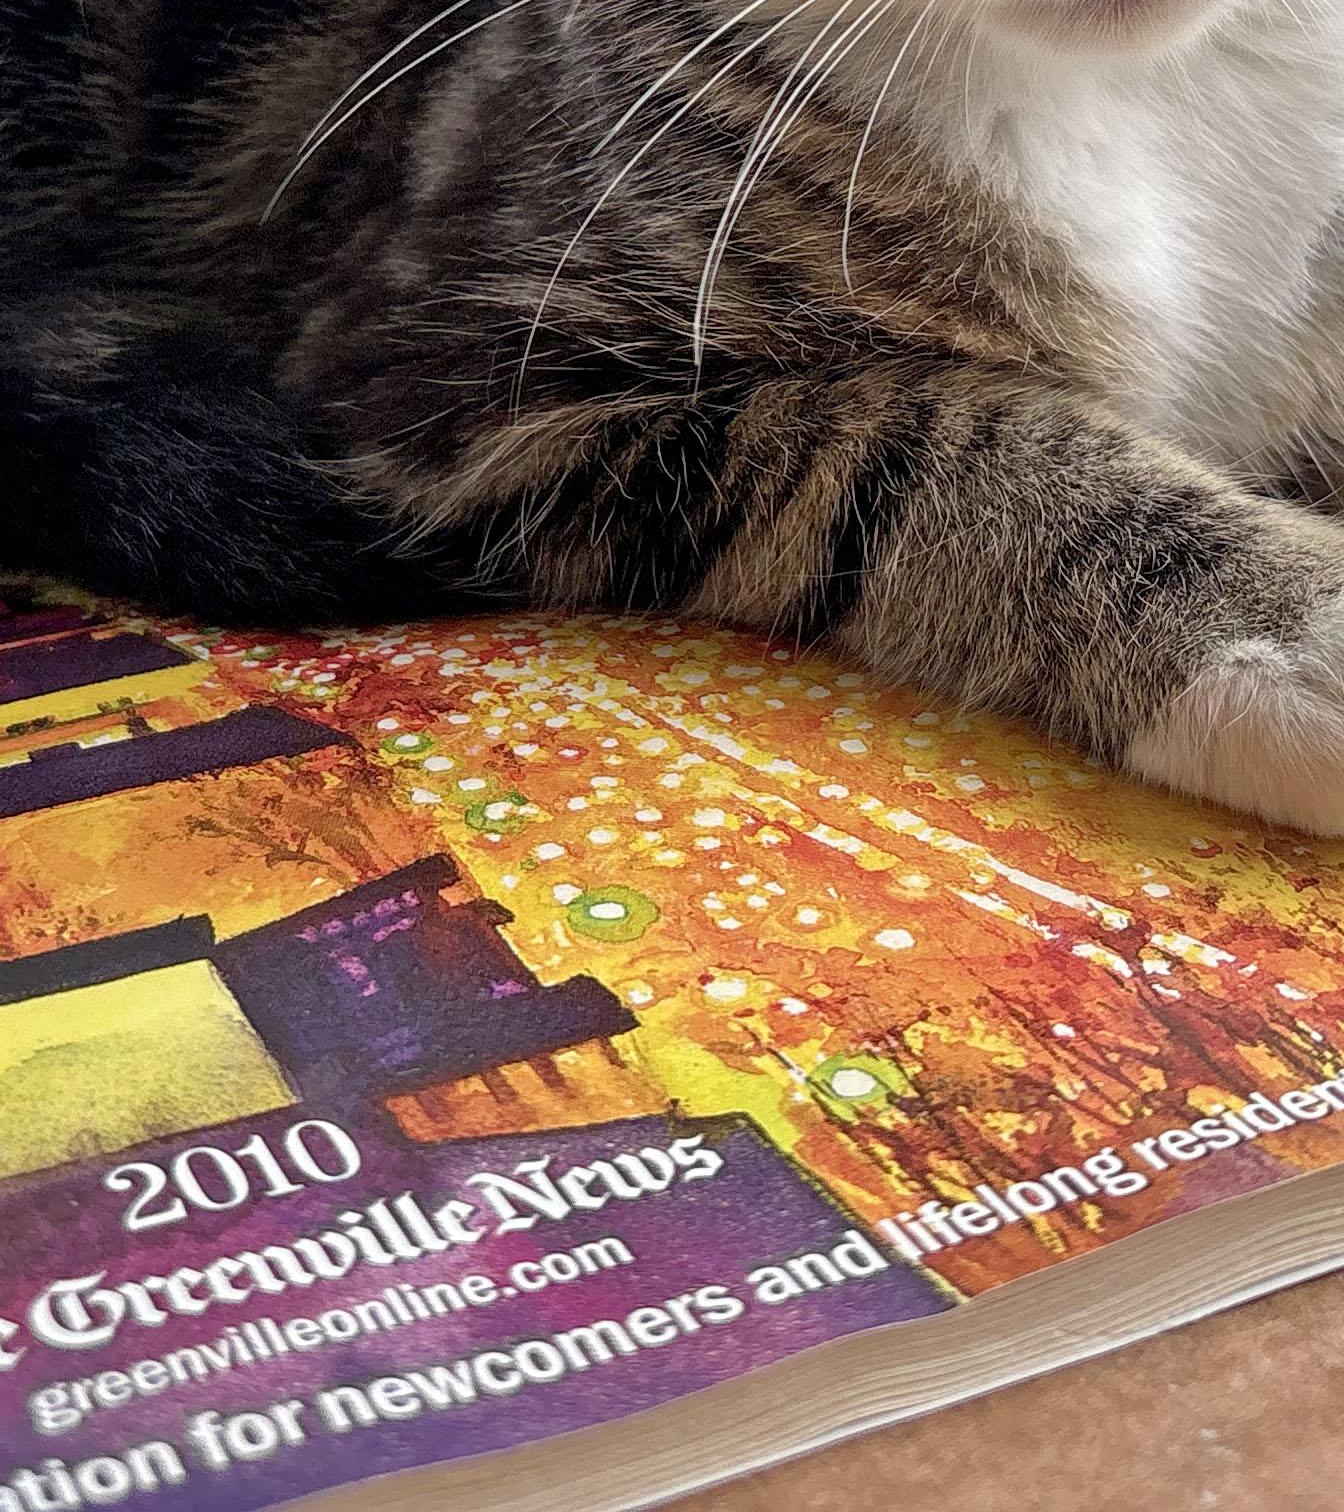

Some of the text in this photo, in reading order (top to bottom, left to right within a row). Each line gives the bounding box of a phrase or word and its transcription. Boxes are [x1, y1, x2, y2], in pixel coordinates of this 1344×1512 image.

[26, 1191, 487, 1348] Greenville
[465, 1133, 724, 1234] News
[104, 1119, 362, 1231] 2010
[27, 1236, 634, 1435] greenvilleonline.com
[188, 1397, 305, 1469] for
[316, 1285, 745, 1432] newcomers
[746, 1230, 891, 1305] and
[878, 1147, 1148, 1261] lifelong
